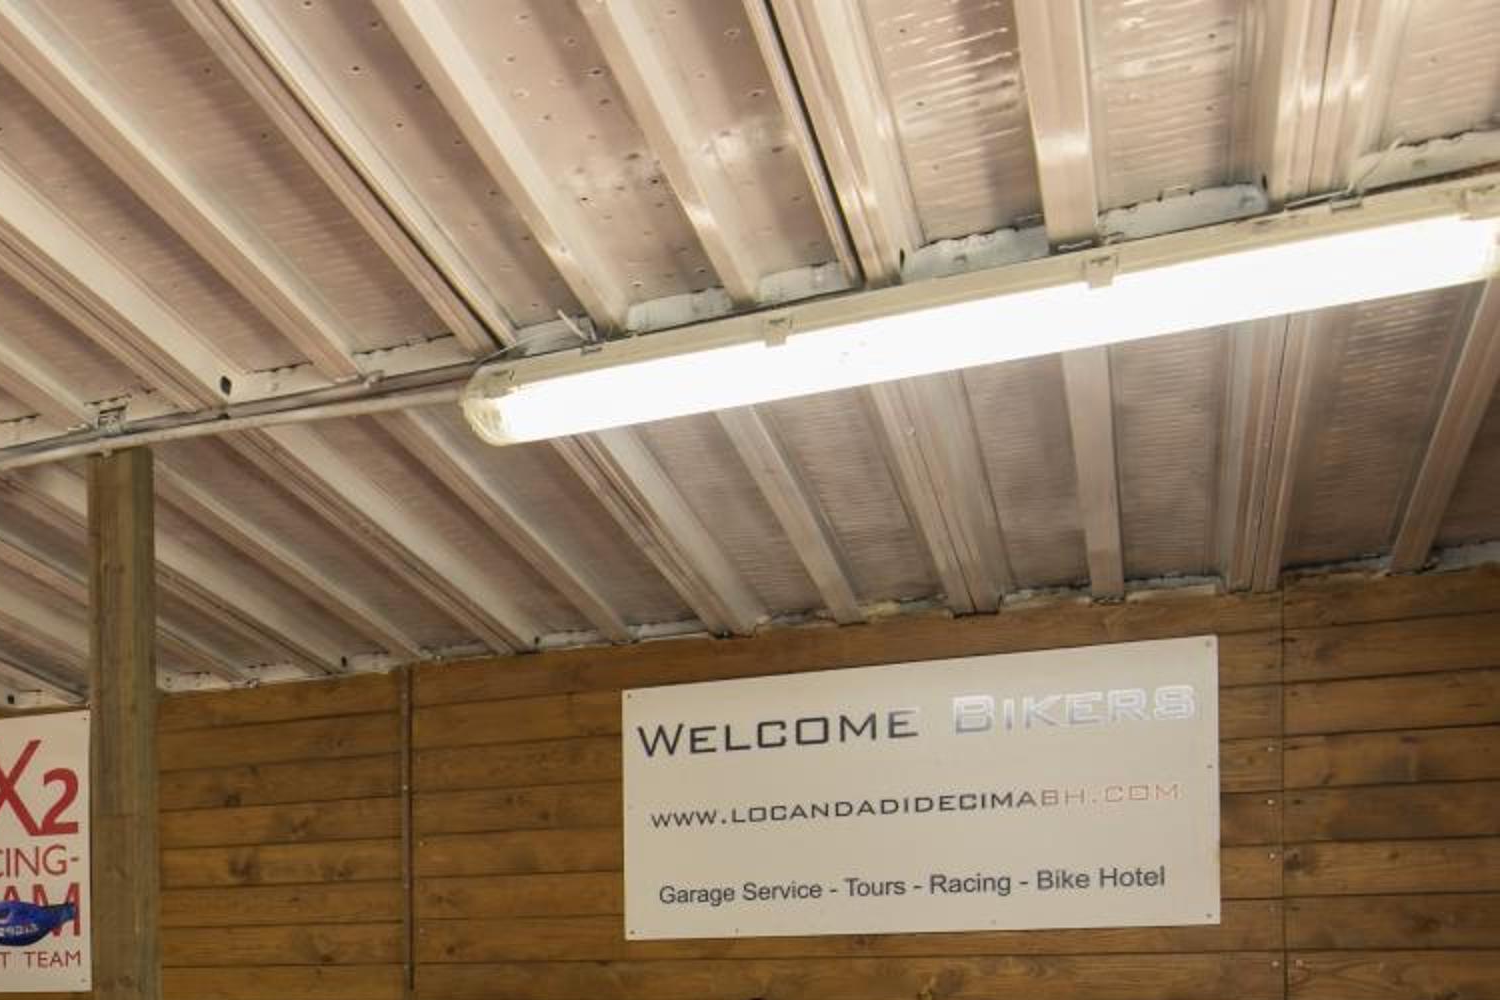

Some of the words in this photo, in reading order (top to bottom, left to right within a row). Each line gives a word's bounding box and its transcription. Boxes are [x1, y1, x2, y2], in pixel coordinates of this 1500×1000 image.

[637, 709, 919, 757] WELCOME
[953, 684, 1197, 734] BIKERS
[659, 884, 735, 907] Garage
[742, 880, 823, 901] Service
[845, 877, 907, 897] Tours
[929, 872, 1012, 896] Racing
[1037, 869, 1091, 890] Bike
[1100, 865, 1166, 888] Hotel
[24, 951, 81, 968] TEAM
